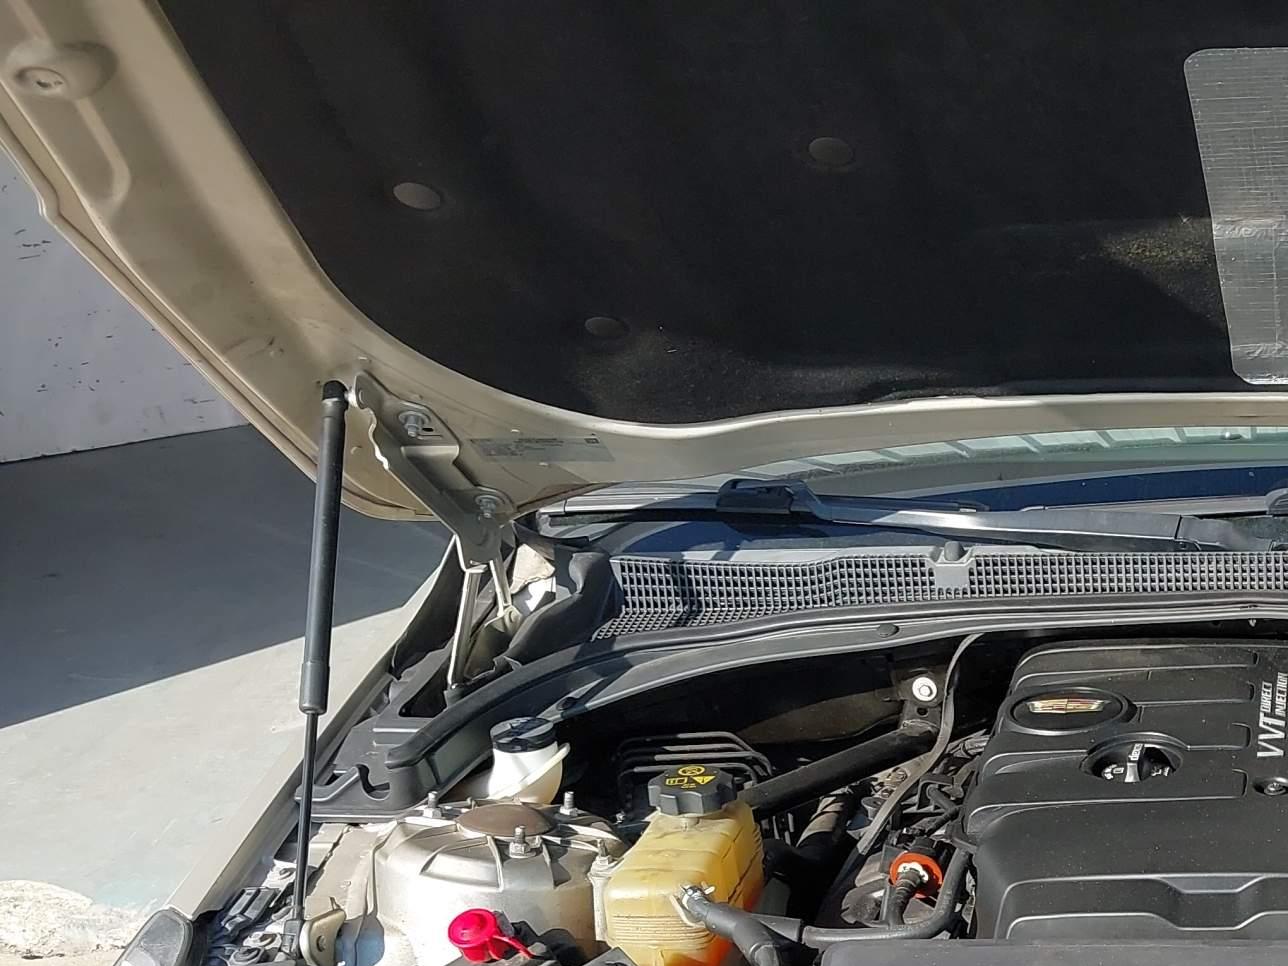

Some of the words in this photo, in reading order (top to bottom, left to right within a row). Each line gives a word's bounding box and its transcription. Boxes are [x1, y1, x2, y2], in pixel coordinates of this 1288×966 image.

[1260, 681, 1272, 713] DIRECT
[1275, 671, 1288, 717] INJECTION
[1257, 711, 1286, 758] VVT
